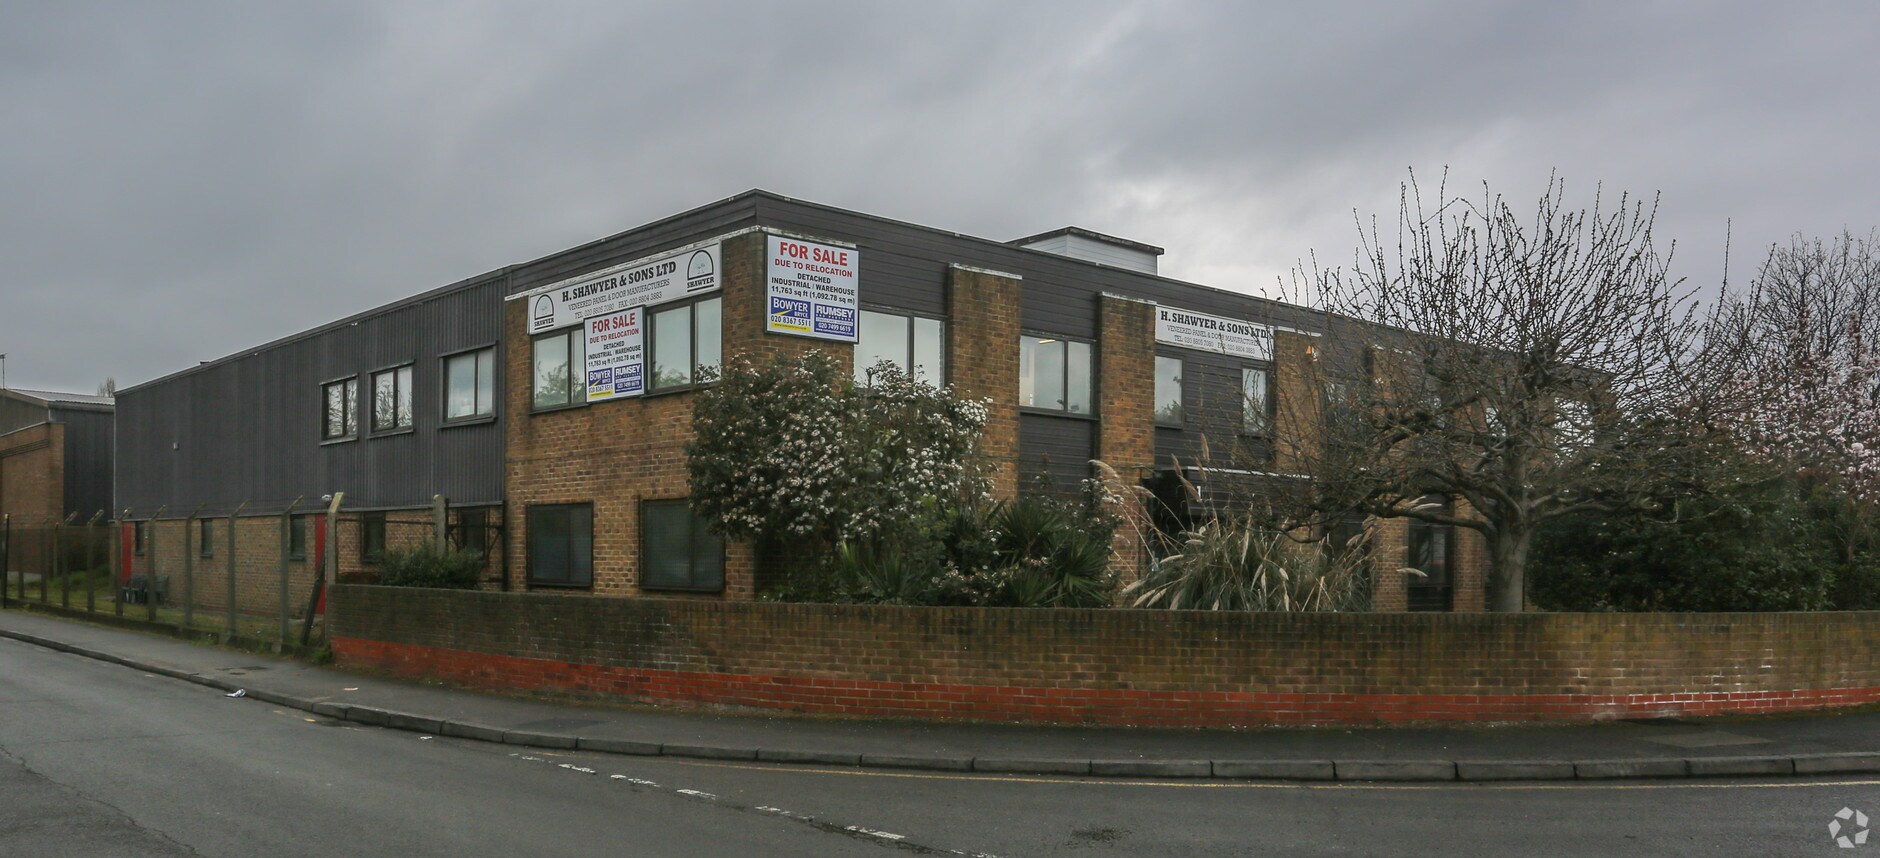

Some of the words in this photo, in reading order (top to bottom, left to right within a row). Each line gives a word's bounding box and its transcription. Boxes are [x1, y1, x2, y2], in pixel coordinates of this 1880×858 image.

[780, 241, 808, 260] FOR
[813, 248, 848, 267] SALE
[775, 259, 791, 268] DUE
[793, 262, 803, 270] TO
[805, 264, 853, 278] RELOCATION
[562, 290, 572, 302] H.
[572, 277, 618, 300] SHAWYER
[619, 275, 627, 287] &
[628, 267, 654, 285] SONS
[656, 261, 677, 277] LTD
[687, 277, 715, 289] SHAWYER
[797, 273, 832, 284] DETACHED
[771, 277, 811, 289] INDUSTRIAL
[816, 284, 855, 296] WAREHOUSE
[612, 289, 627, 300] DOOR
[771, 286, 793, 295] 11,763
[794, 290, 802, 298] sq
[809, 292, 838, 302] (1,092.78
[839, 297, 846, 305] sq
[773, 298, 808, 312] BOWYER
[815, 305, 854, 318] RUMSEY
[592, 318, 610, 334] FOR
[612, 312, 635, 330] SALE
[771, 315, 781, 323] 020
[783, 316, 797, 325] 8367
[798, 318, 811, 327] 5511
[818, 322, 827, 330] 020
[1161, 310, 1171, 321] H.
[1172, 313, 1217, 330] SHAWYER
[1218, 321, 1226, 332] &
[1227, 323, 1249, 336] SONS
[589, 336, 600, 344] DUE
[601, 334, 607, 342] TO
[608, 328, 640, 341] RELOCATION
[603, 341, 625, 350] DETACHED
[615, 364, 641, 377] RUMSEY
